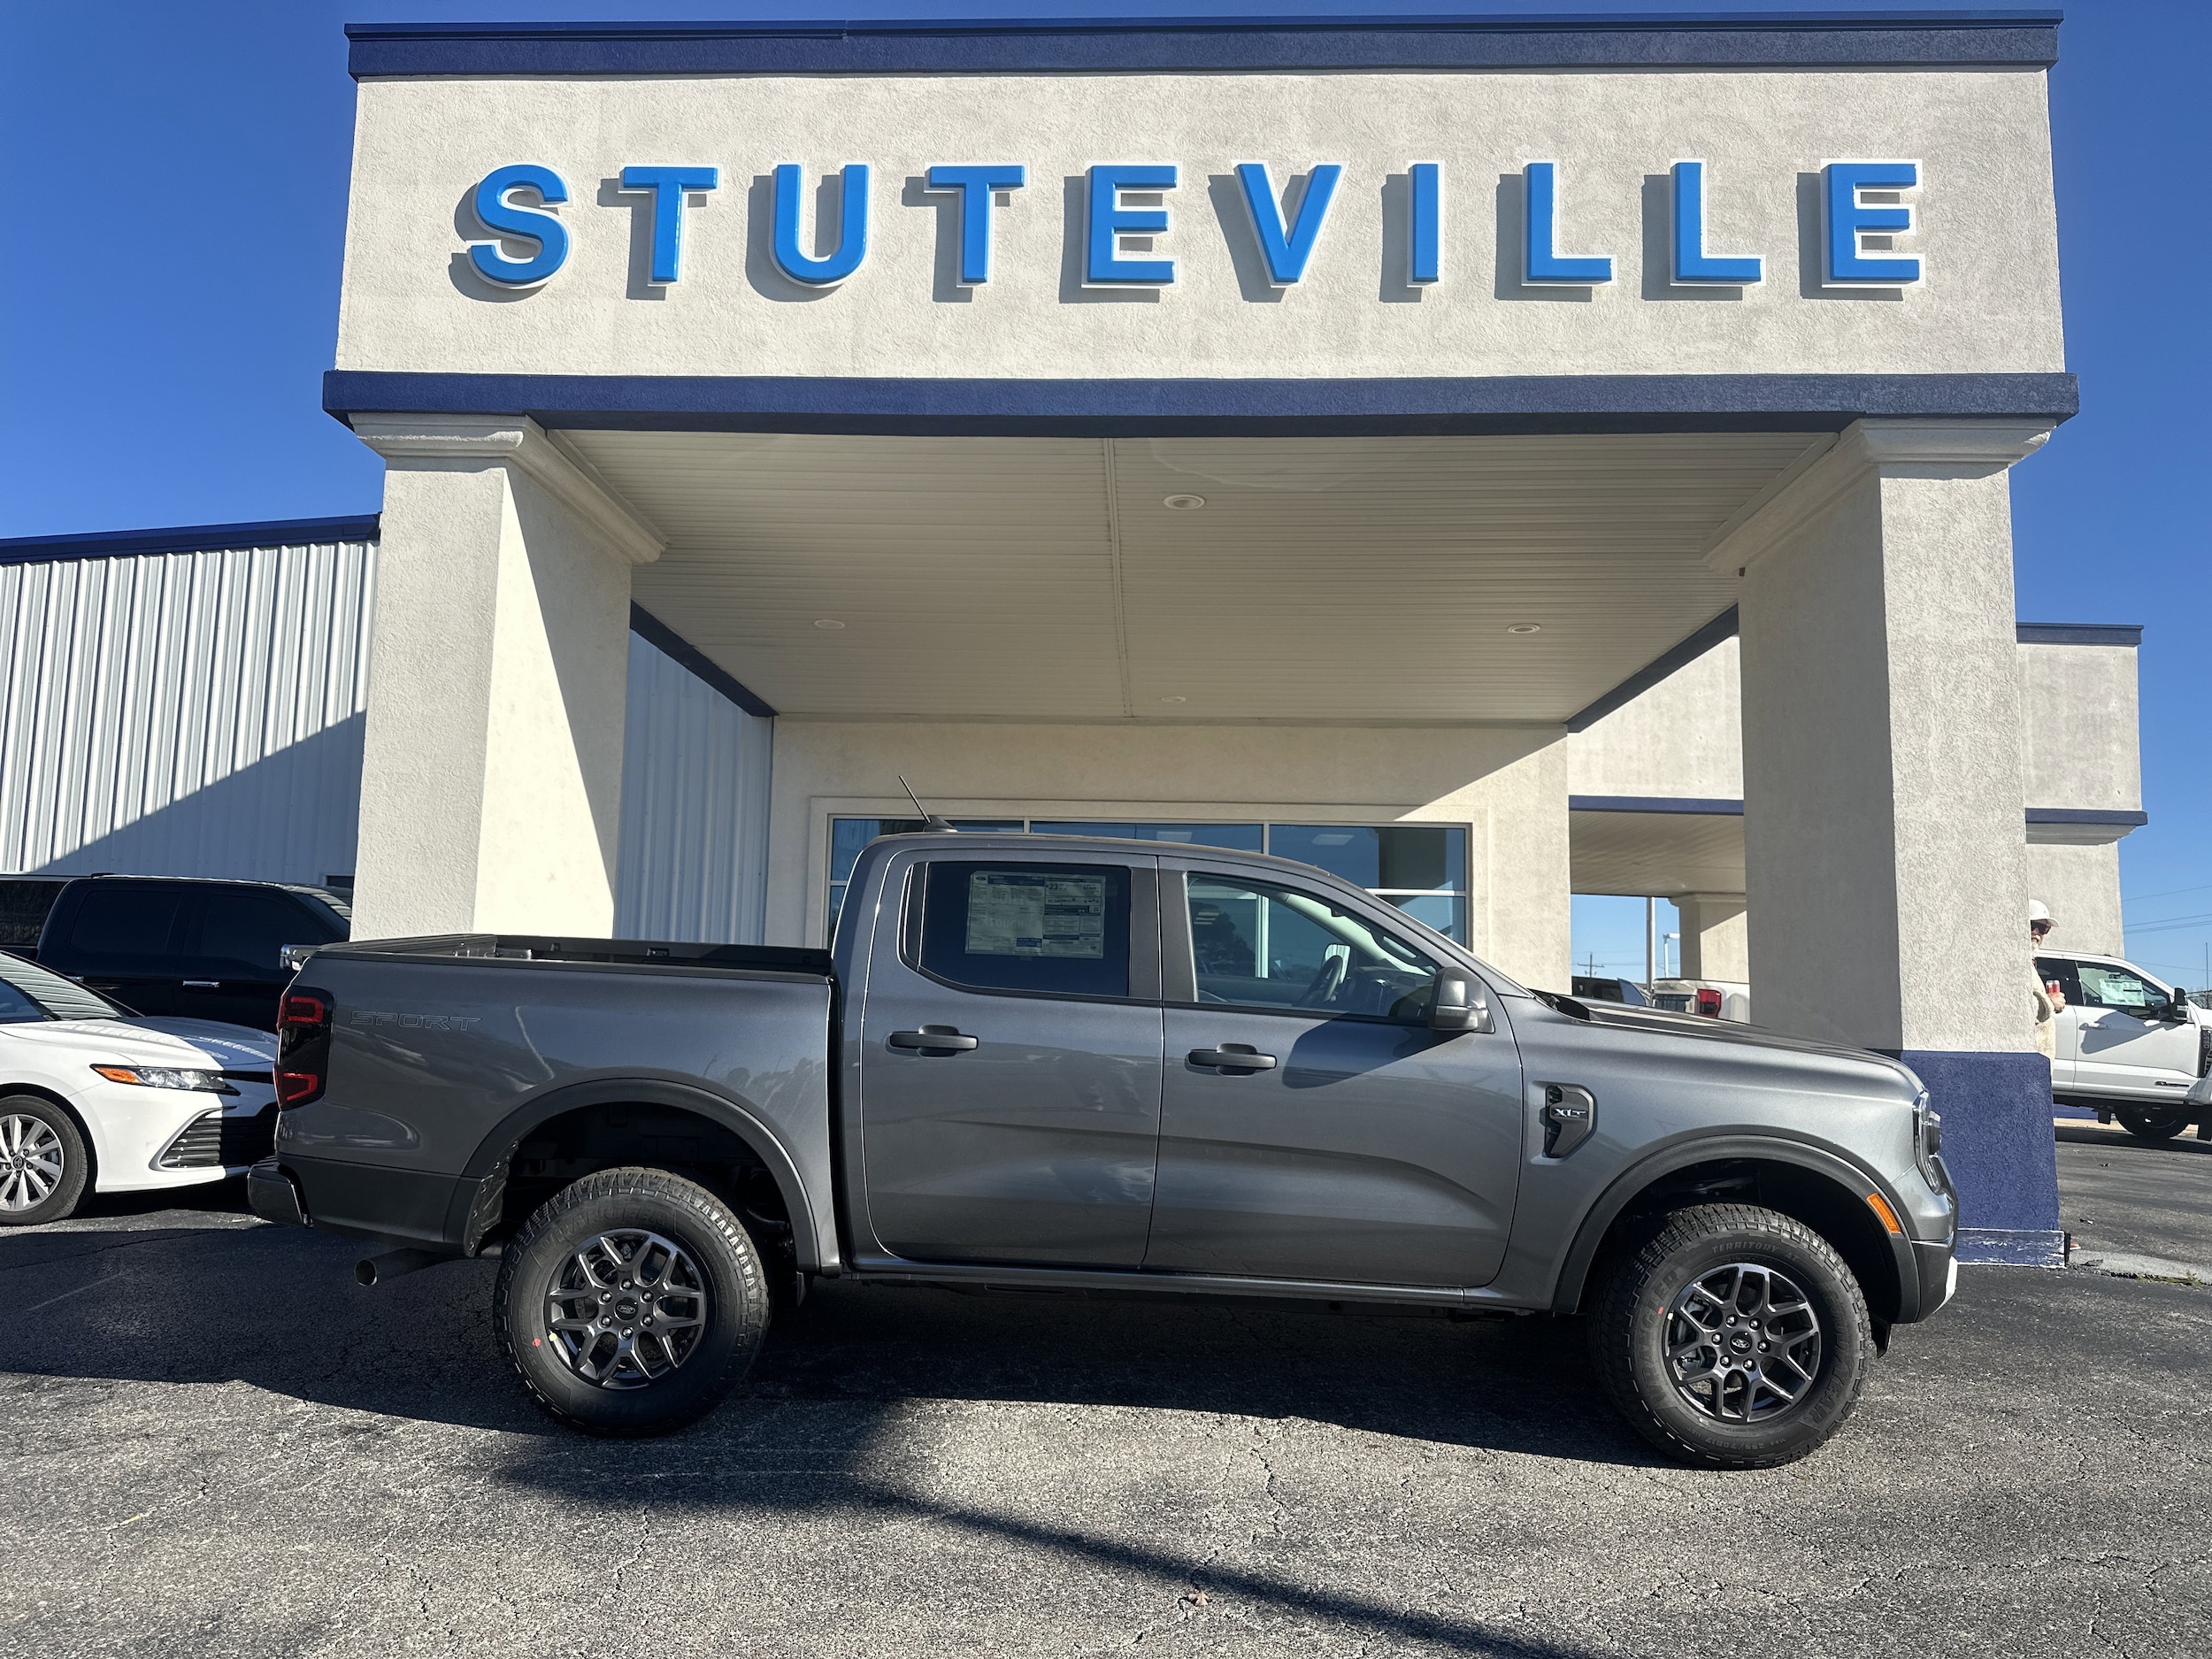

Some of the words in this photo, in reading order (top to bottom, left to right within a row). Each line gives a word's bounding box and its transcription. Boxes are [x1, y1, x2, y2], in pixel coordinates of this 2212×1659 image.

[469, 159, 1924, 288] STUTEVILLE
[349, 1010, 483, 1032] SPORT
[1554, 1108, 1586, 1119] XLT
[1712, 1241, 1779, 1254] TERRITORY
[1638, 1268, 1680, 1405] WRANGLER
[1809, 1286, 1855, 1424] GOODYEAR
